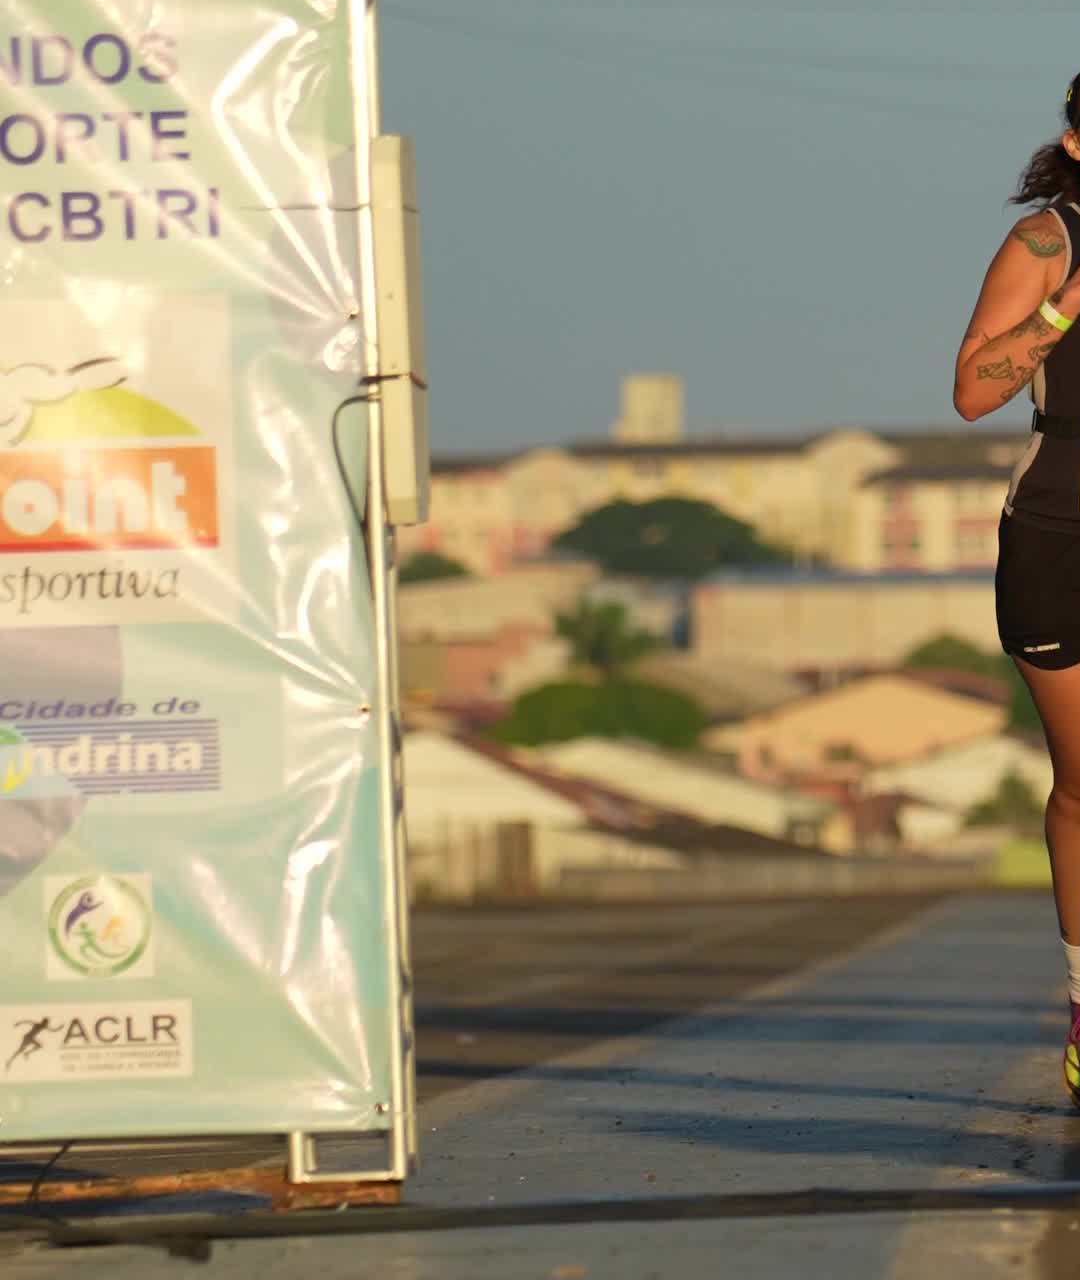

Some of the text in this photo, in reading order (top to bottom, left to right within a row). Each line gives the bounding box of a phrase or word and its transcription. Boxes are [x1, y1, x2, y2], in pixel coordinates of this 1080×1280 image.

[0, 110, 191, 166] ORTE
[8, 187, 220, 244] CBTRI
[2, 448, 188, 537] oint
[0, 563, 181, 615] sportiva
[0, 696, 201, 721] Cidade de
[63, 1013, 178, 1044] ACLR
